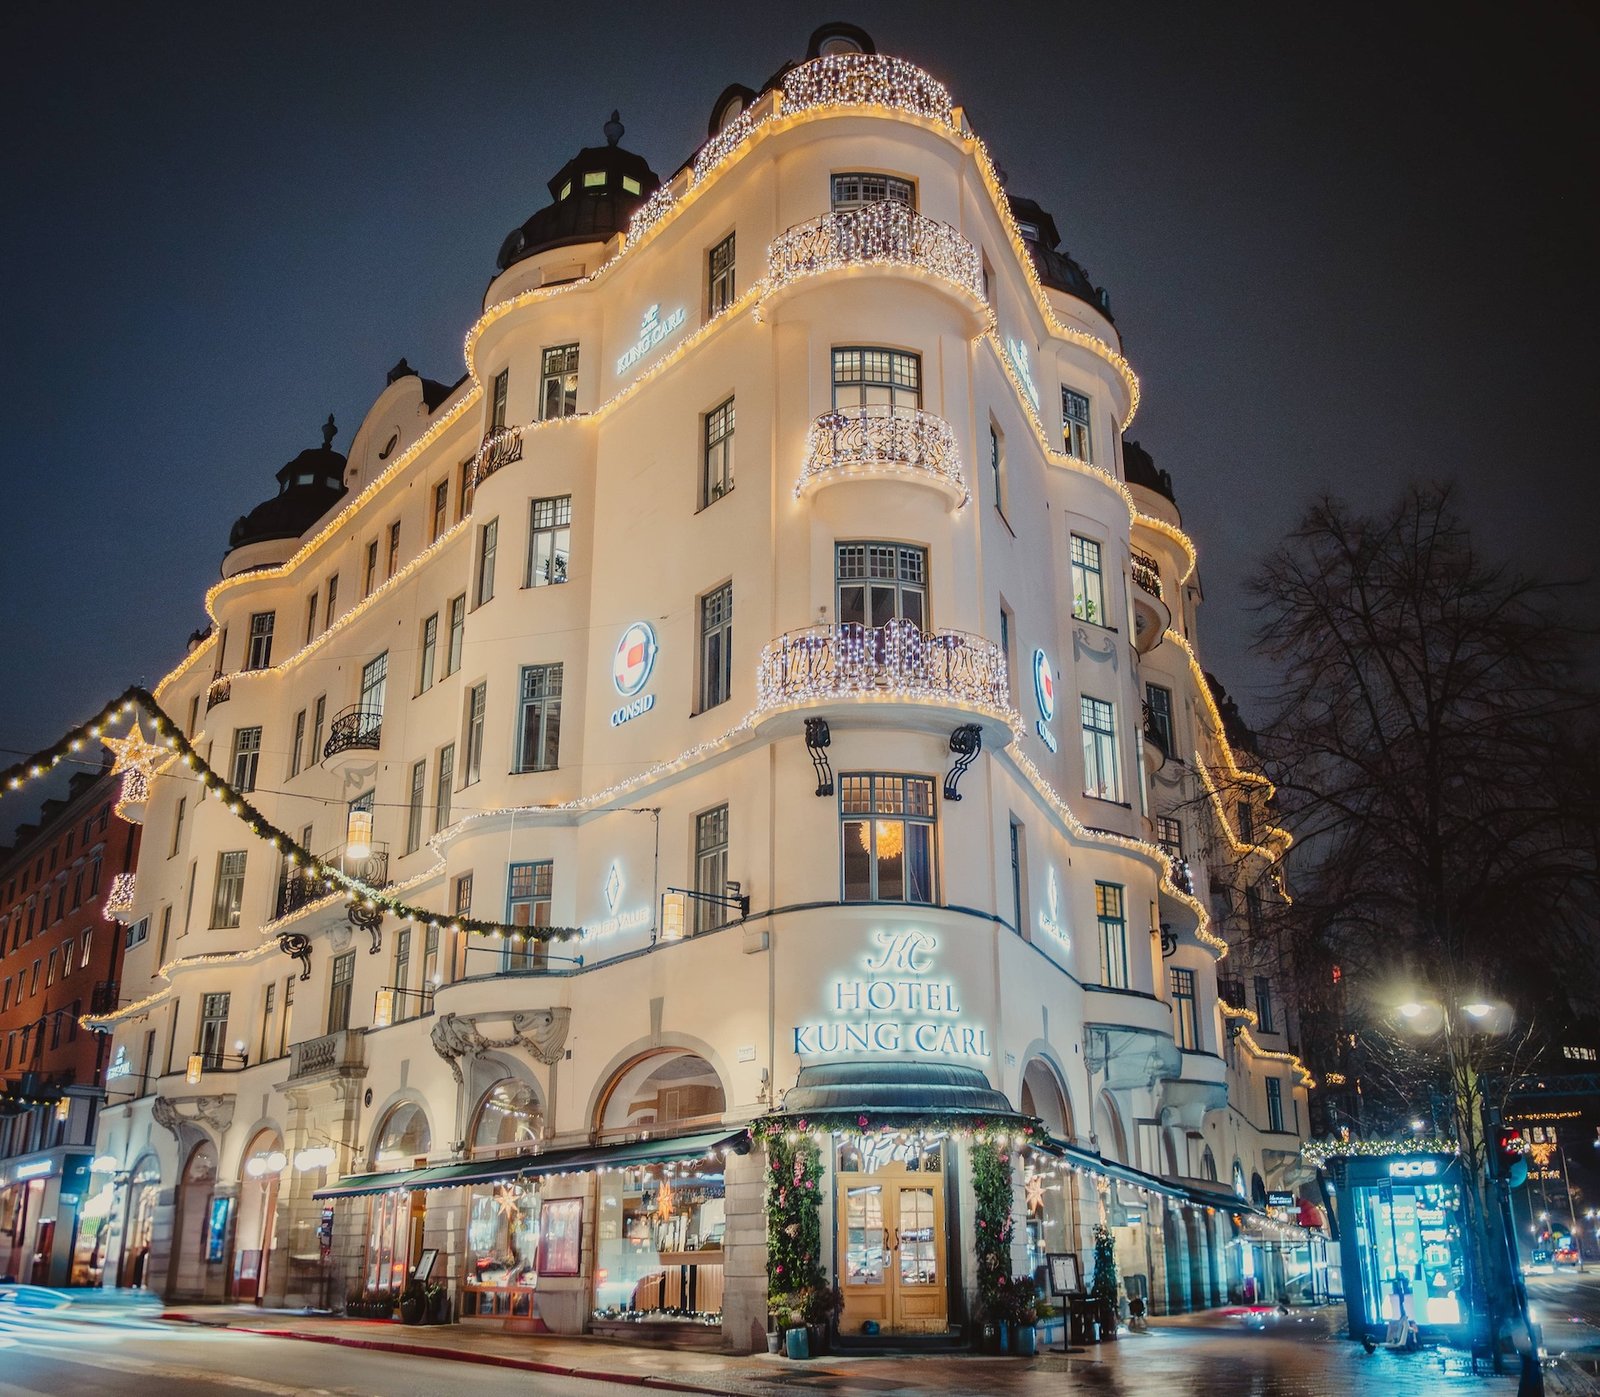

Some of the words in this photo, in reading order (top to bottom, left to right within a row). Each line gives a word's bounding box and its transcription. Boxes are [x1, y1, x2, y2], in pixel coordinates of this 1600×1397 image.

[616, 335, 651, 375] KUNG
[651, 307, 685, 345] CARL
[610, 694, 655, 727] CONSID
[836, 981, 960, 1013] HOTEL
[792, 1022, 901, 1055] KUNG
[914, 1023, 991, 1057] CARL
[1389, 1160, 1437, 1178] IQOS
